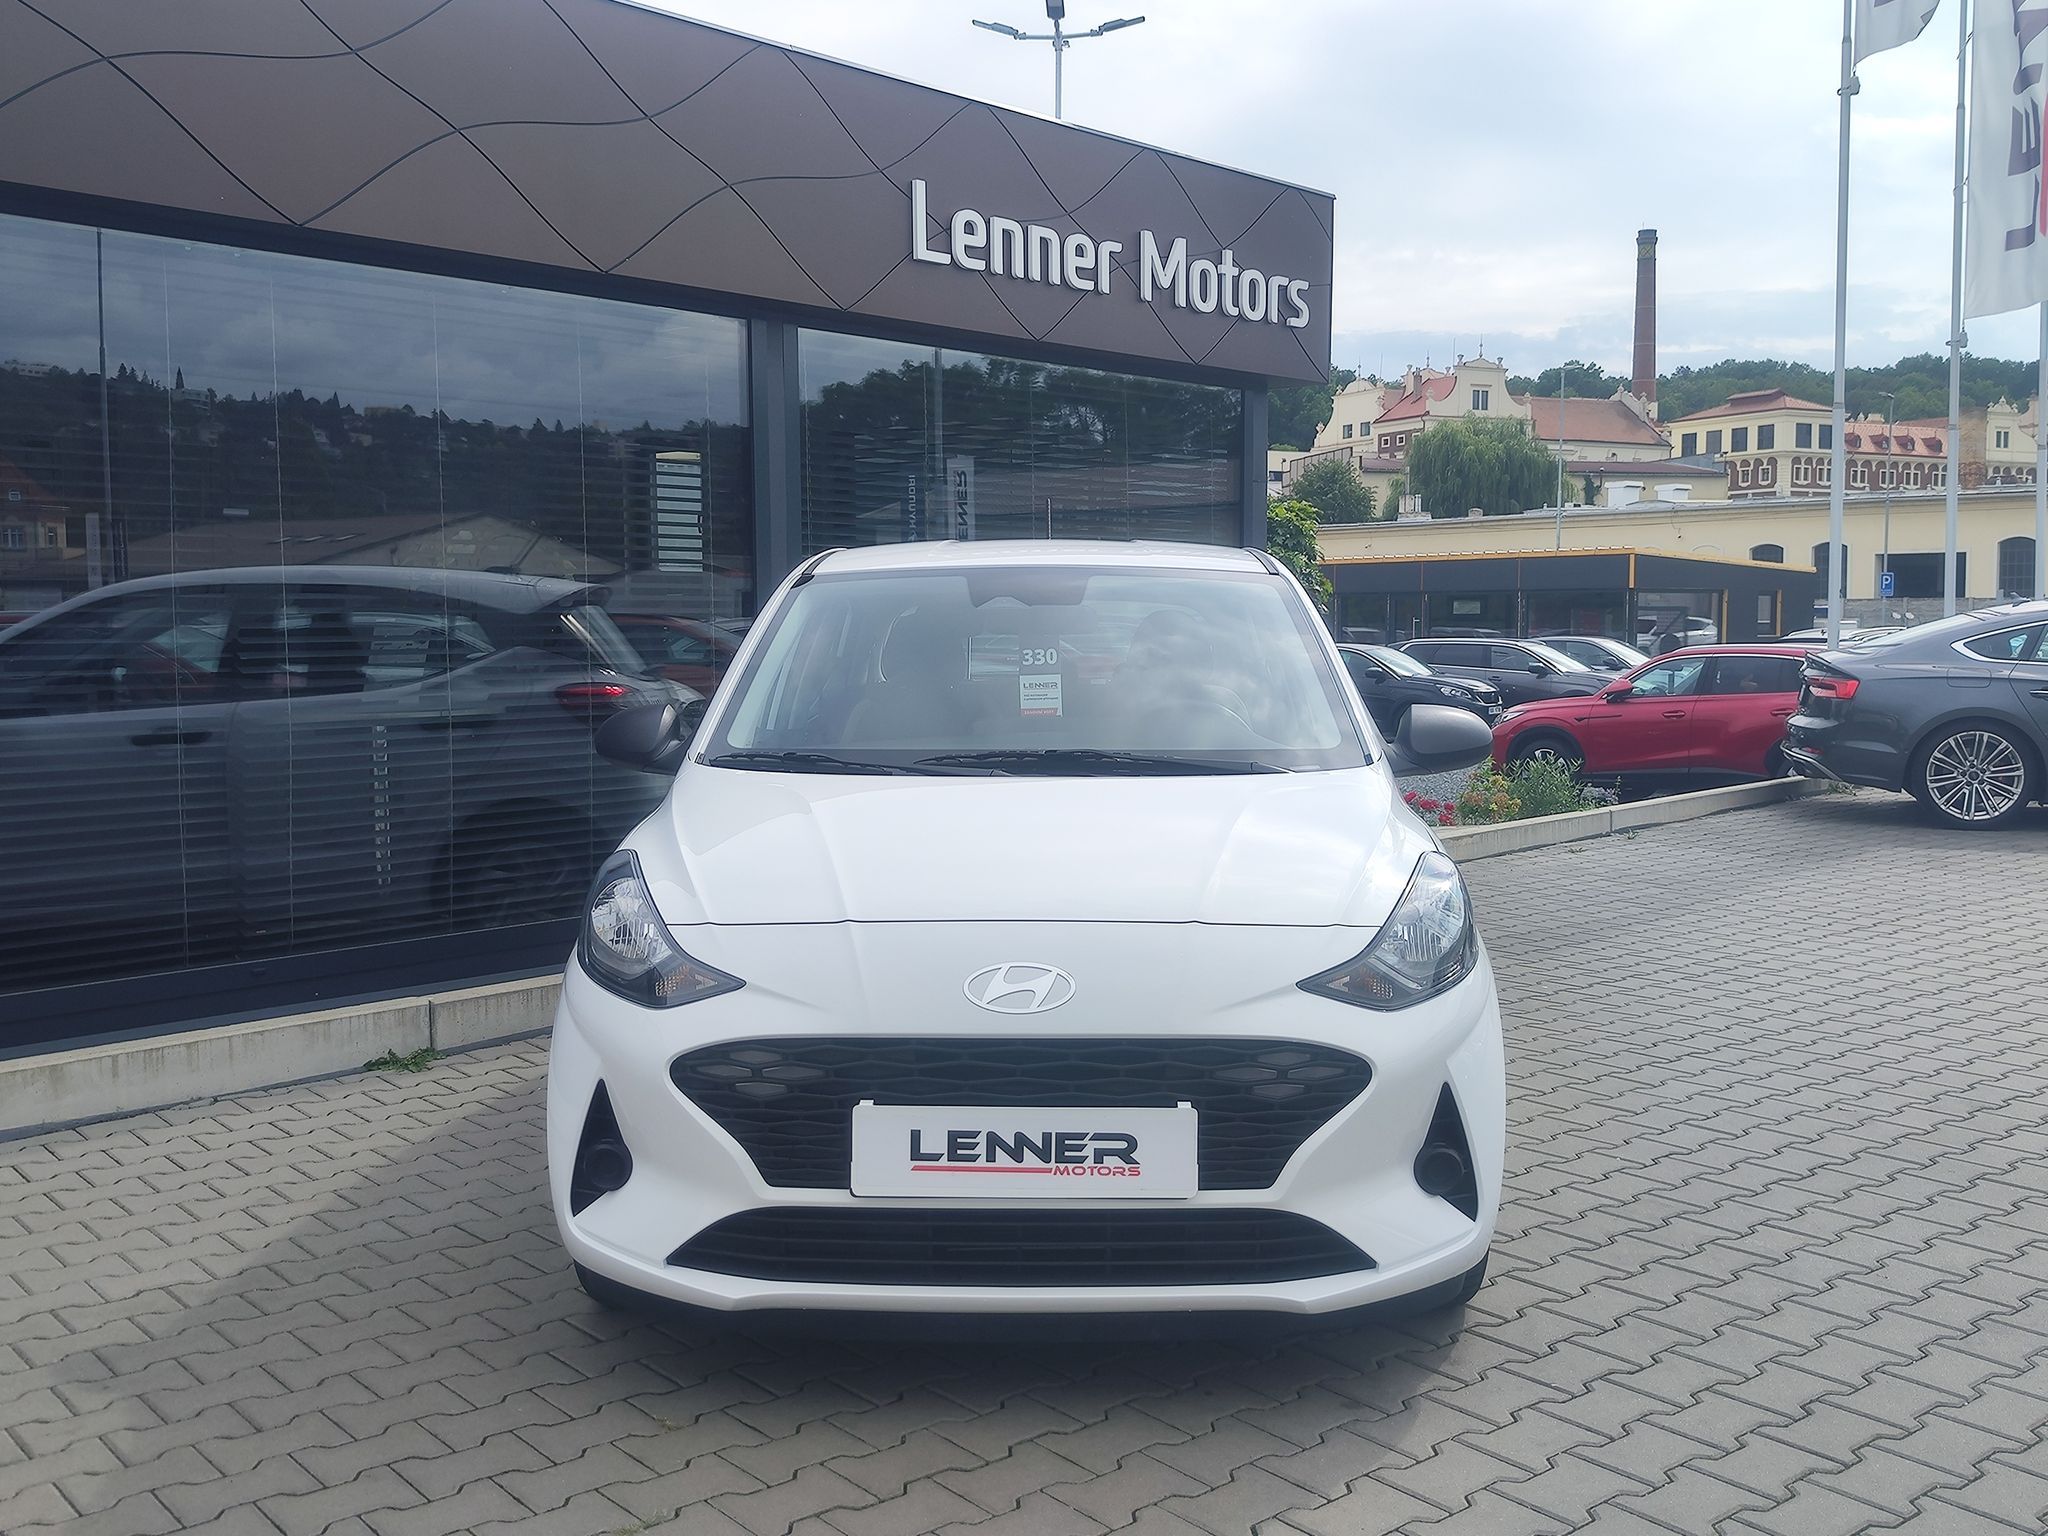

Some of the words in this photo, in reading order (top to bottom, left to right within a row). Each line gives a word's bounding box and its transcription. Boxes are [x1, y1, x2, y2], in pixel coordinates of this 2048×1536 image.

[910, 178, 1123, 295] Lenner
[1139, 229, 1310, 328] Motors
[1882, 575, 1891, 589] P
[1022, 648, 1058, 666] 330
[1023, 681, 1059, 690] LENNER
[910, 1129, 1141, 1165] LENNER
[1052, 1165, 1141, 1177] MOTORS
